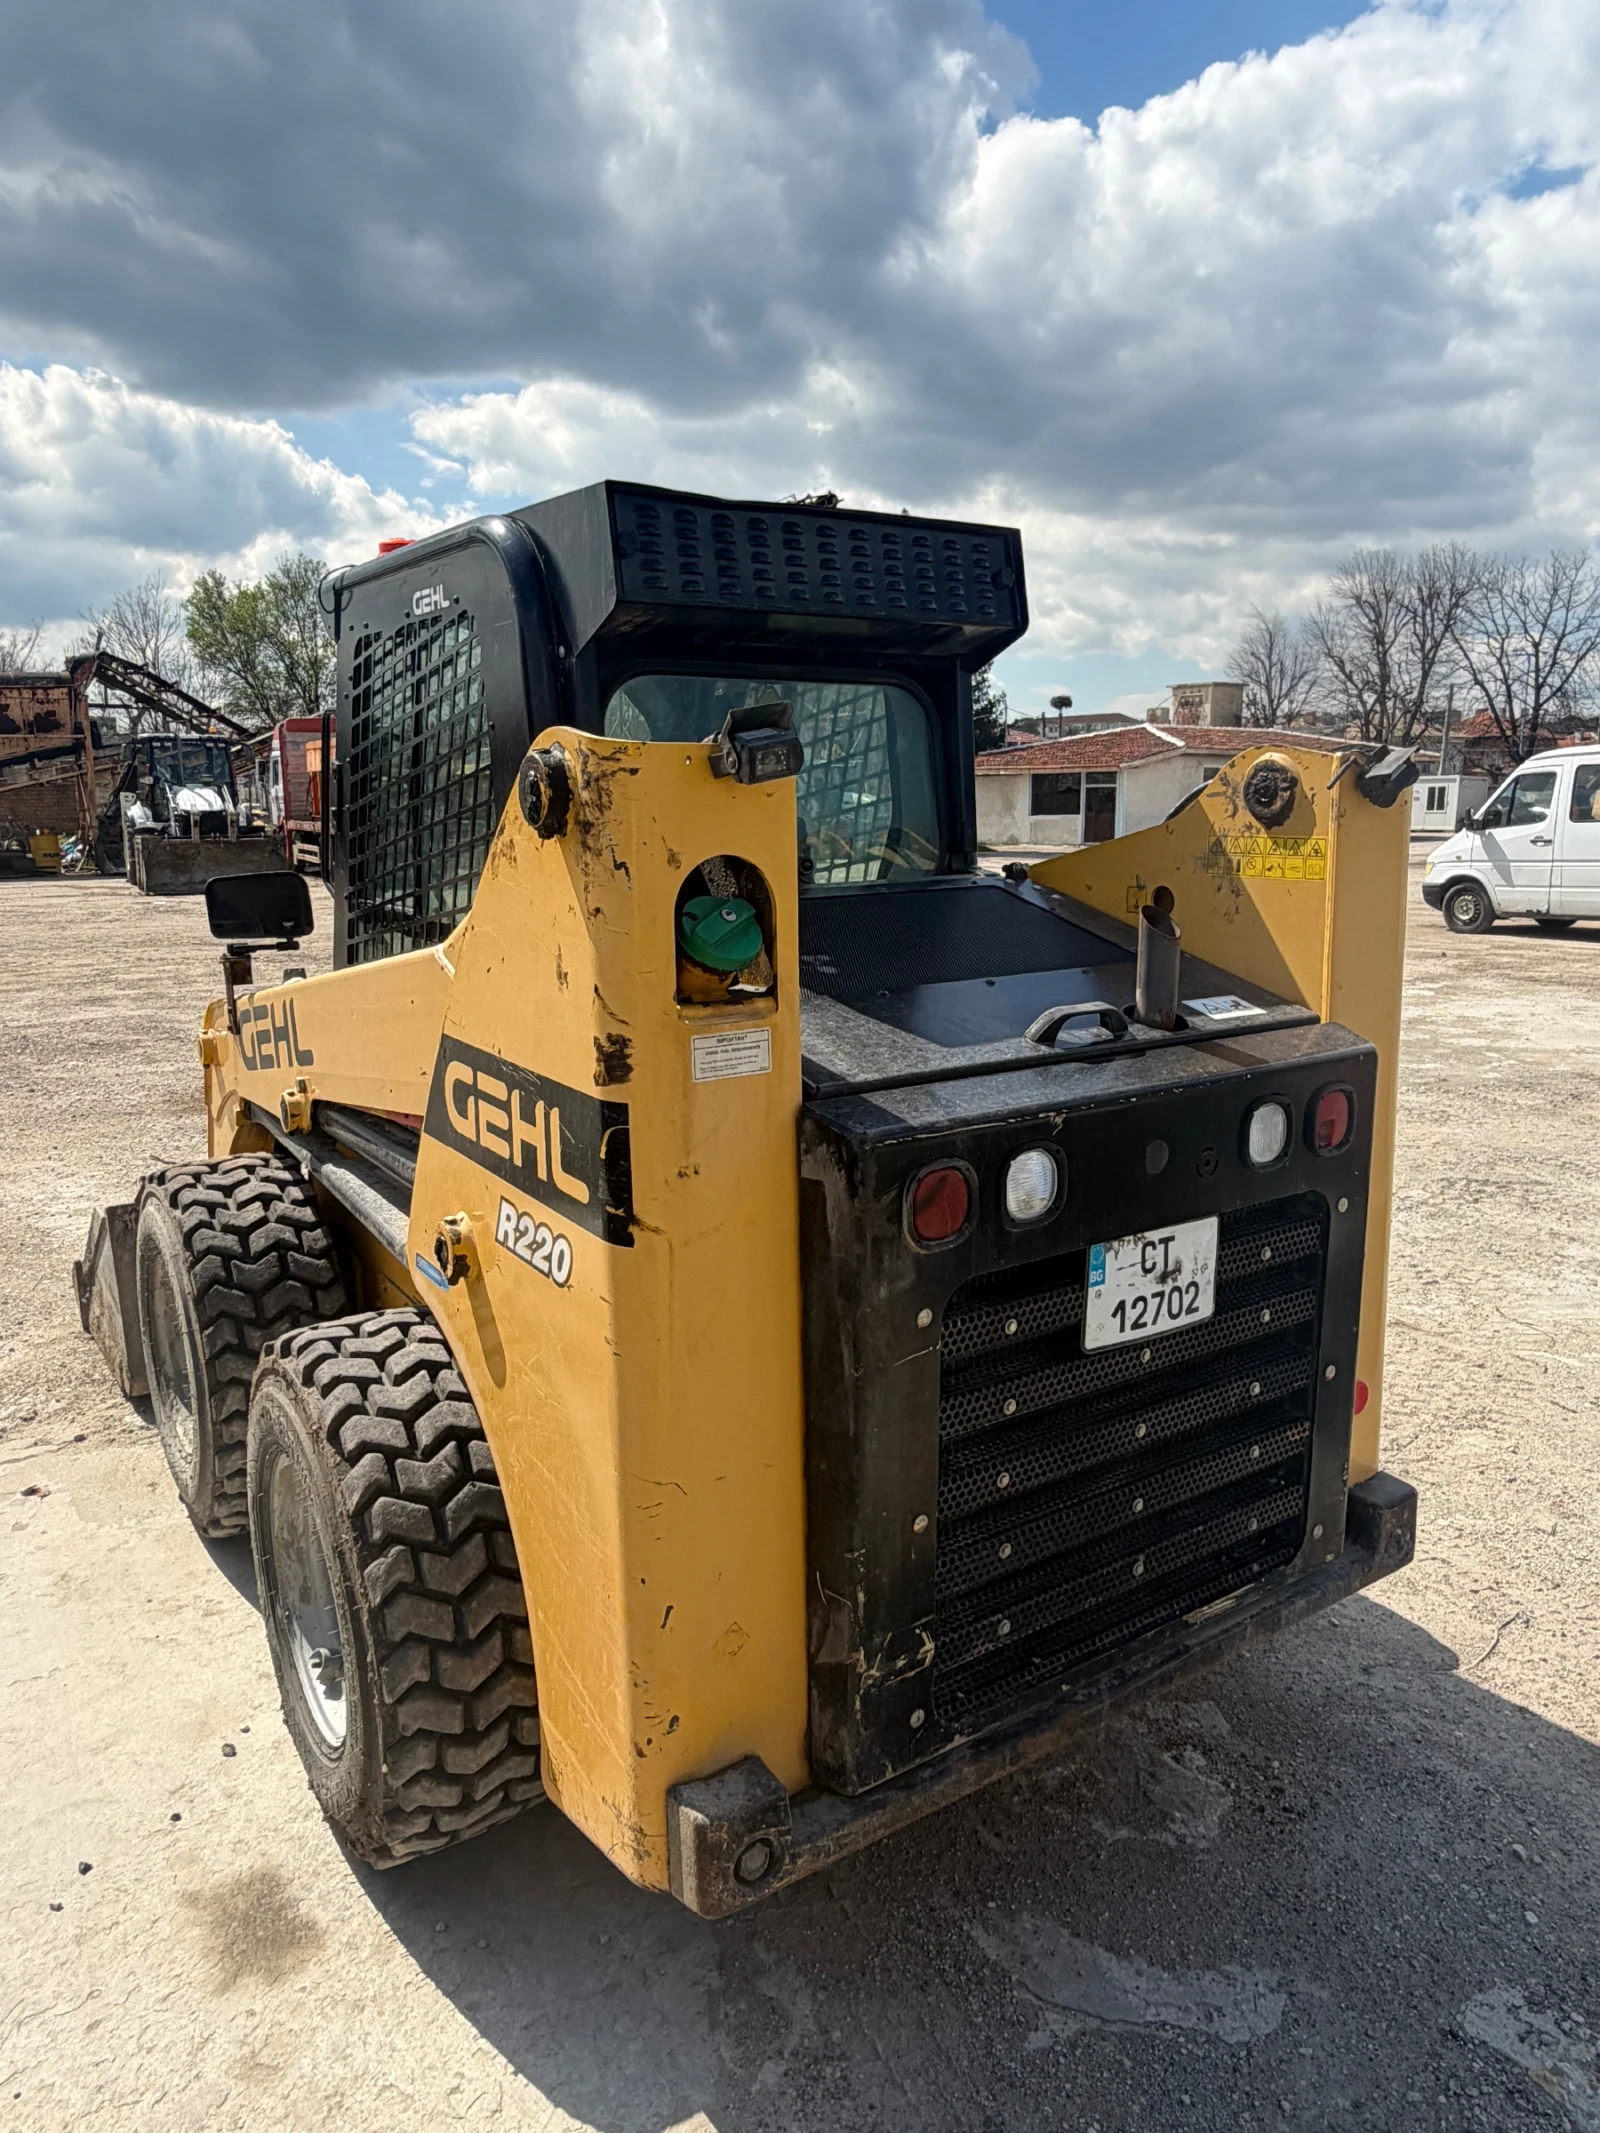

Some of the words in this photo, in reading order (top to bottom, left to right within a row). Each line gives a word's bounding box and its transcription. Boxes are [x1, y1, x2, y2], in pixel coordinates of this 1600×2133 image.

[413, 584, 450, 615] GEHL
[239, 997, 314, 1071] GEHL
[444, 1060, 590, 1205] GEHL
[496, 1198, 572, 1286] R220
[1140, 1235, 1176, 1275] CT
[1090, 1269, 1104, 1284] BG
[1110, 1280, 1200, 1334] 12702
